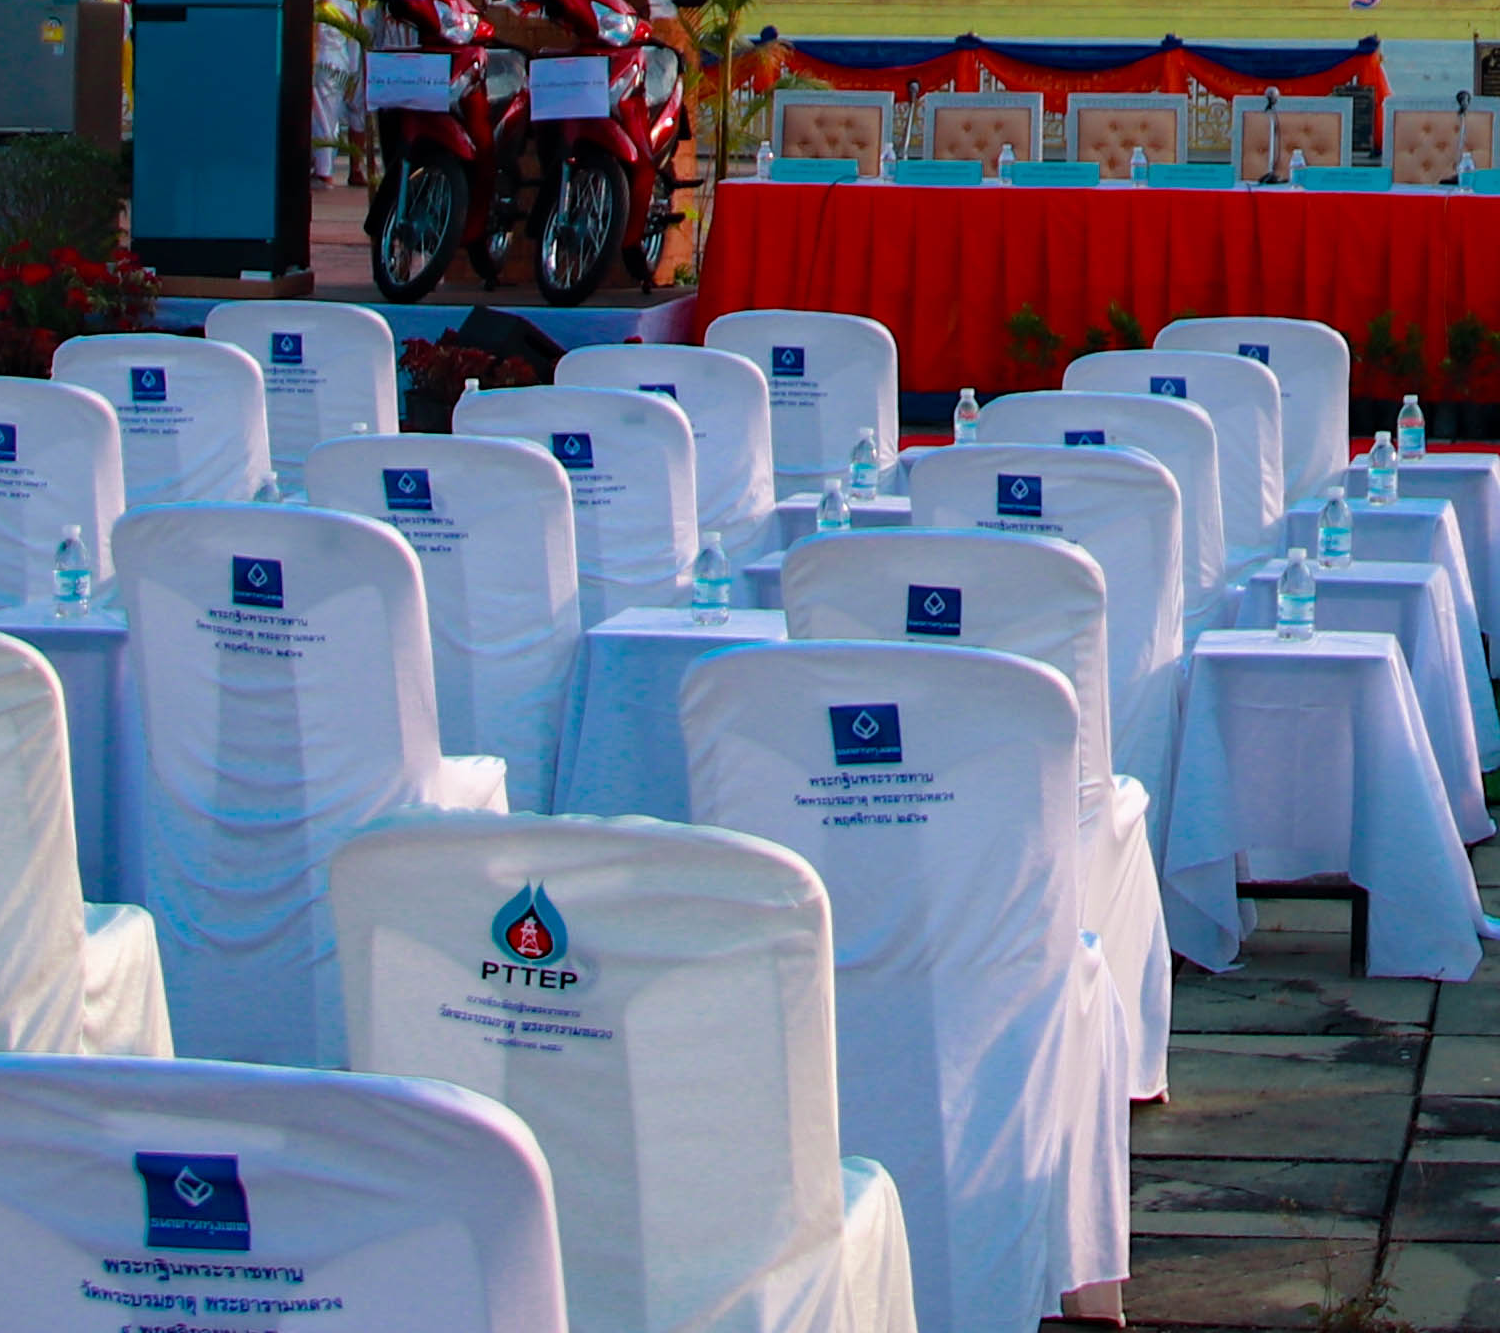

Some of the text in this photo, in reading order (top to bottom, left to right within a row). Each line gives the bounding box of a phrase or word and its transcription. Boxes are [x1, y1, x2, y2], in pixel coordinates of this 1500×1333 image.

[809, 772, 934, 790] พระกฐินพระราชทาน
[481, 961, 579, 990] PTTEP
[104, 1256, 304, 1284] พระกฐินพระราชทาน
[82, 1279, 343, 1316] วัดพระบรมธาตุ พระอารามหลวง
